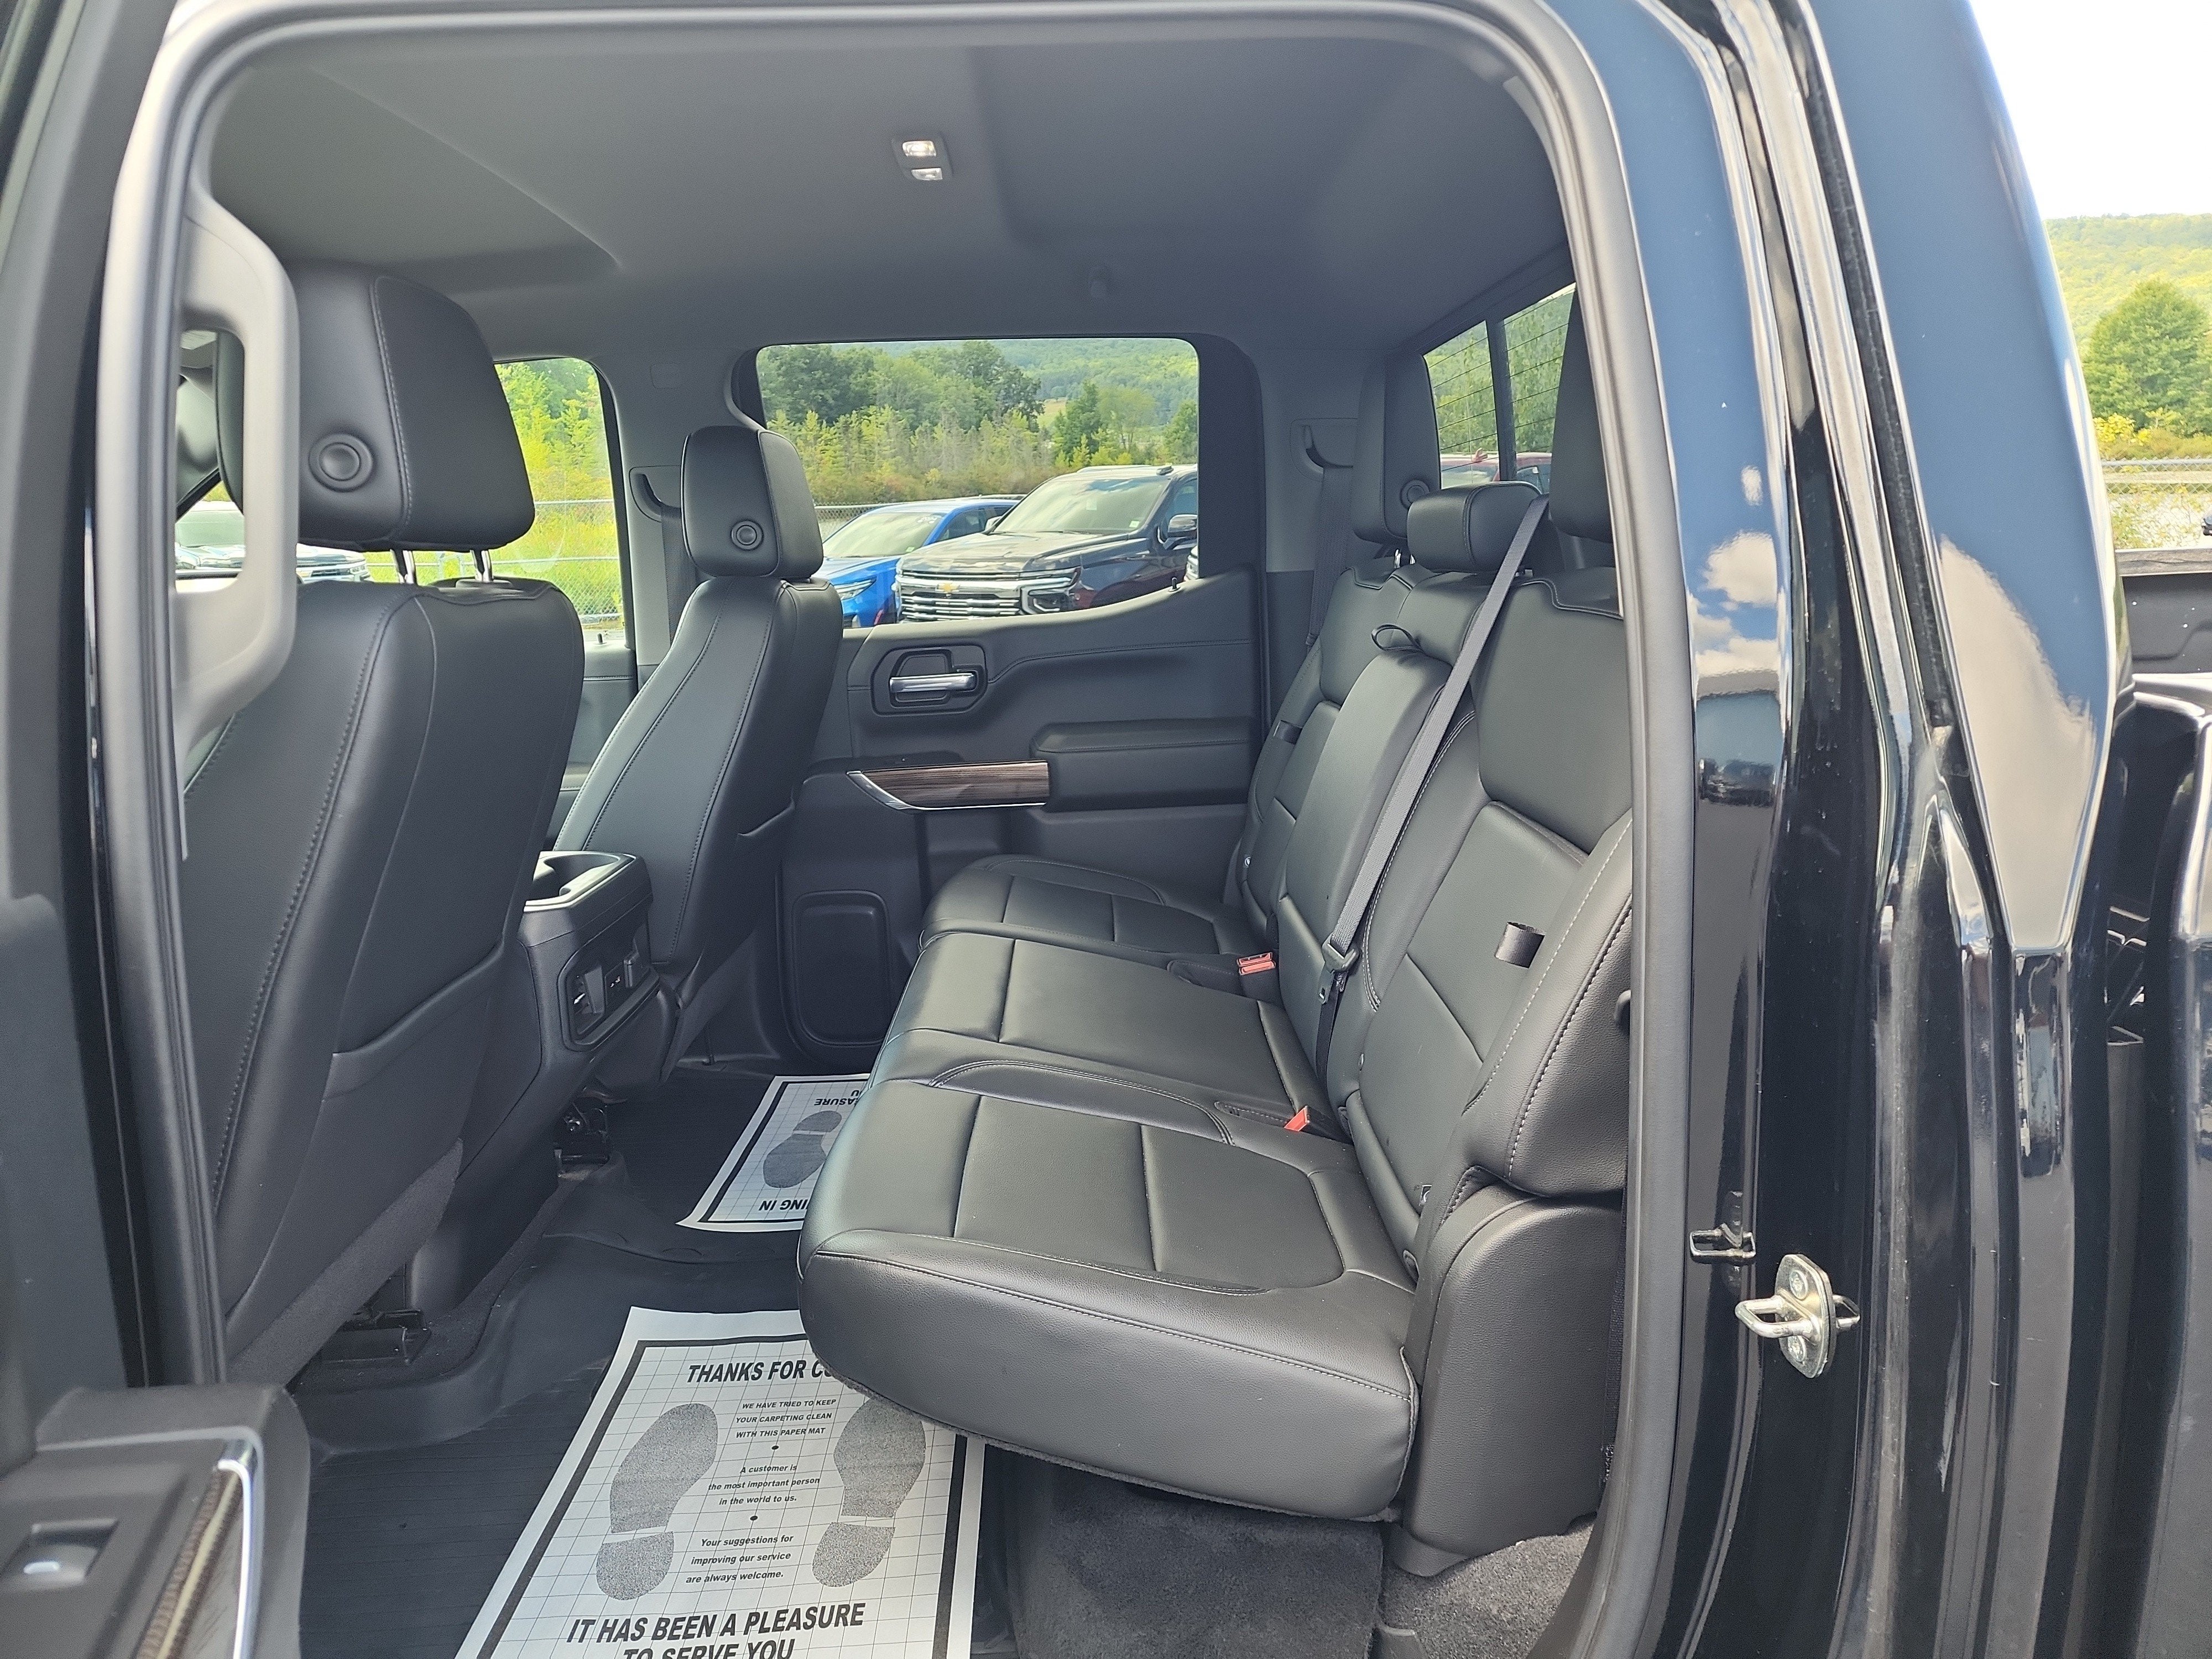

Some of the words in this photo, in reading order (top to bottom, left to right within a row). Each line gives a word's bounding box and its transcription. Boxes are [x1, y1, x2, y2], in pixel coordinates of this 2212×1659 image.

[758, 1199, 778, 1211] IN
[780, 1199, 808, 1211] ING
[687, 1362, 764, 1383] THANKS
[768, 1360, 807, 1380] FOR
[812, 1360, 832, 1378] C
[759, 1415, 804, 1423] CARPETING
[806, 1412, 832, 1421] CLEAN
[748, 1464, 789, 1473] customer
[747, 1479, 789, 1489] important
[791, 1478, 820, 1487] person
[730, 1496, 744, 1505] the
[701, 1538, 721, 1547] Your
[723, 1536, 778, 1546] suggestions
[691, 1555, 737, 1566] improving
[757, 1552, 791, 1561] service
[704, 1573, 737, 1583] always
[739, 1571, 784, 1580] welcome.
[566, 1619, 596, 1643] IT
[596, 1617, 648, 1643] HAS
[650, 1614, 717, 1641] BEEN
[719, 1613, 736, 1637] A
[743, 1603, 866, 1636] PLEASURE
[748, 1639, 796, 1659] YOU
